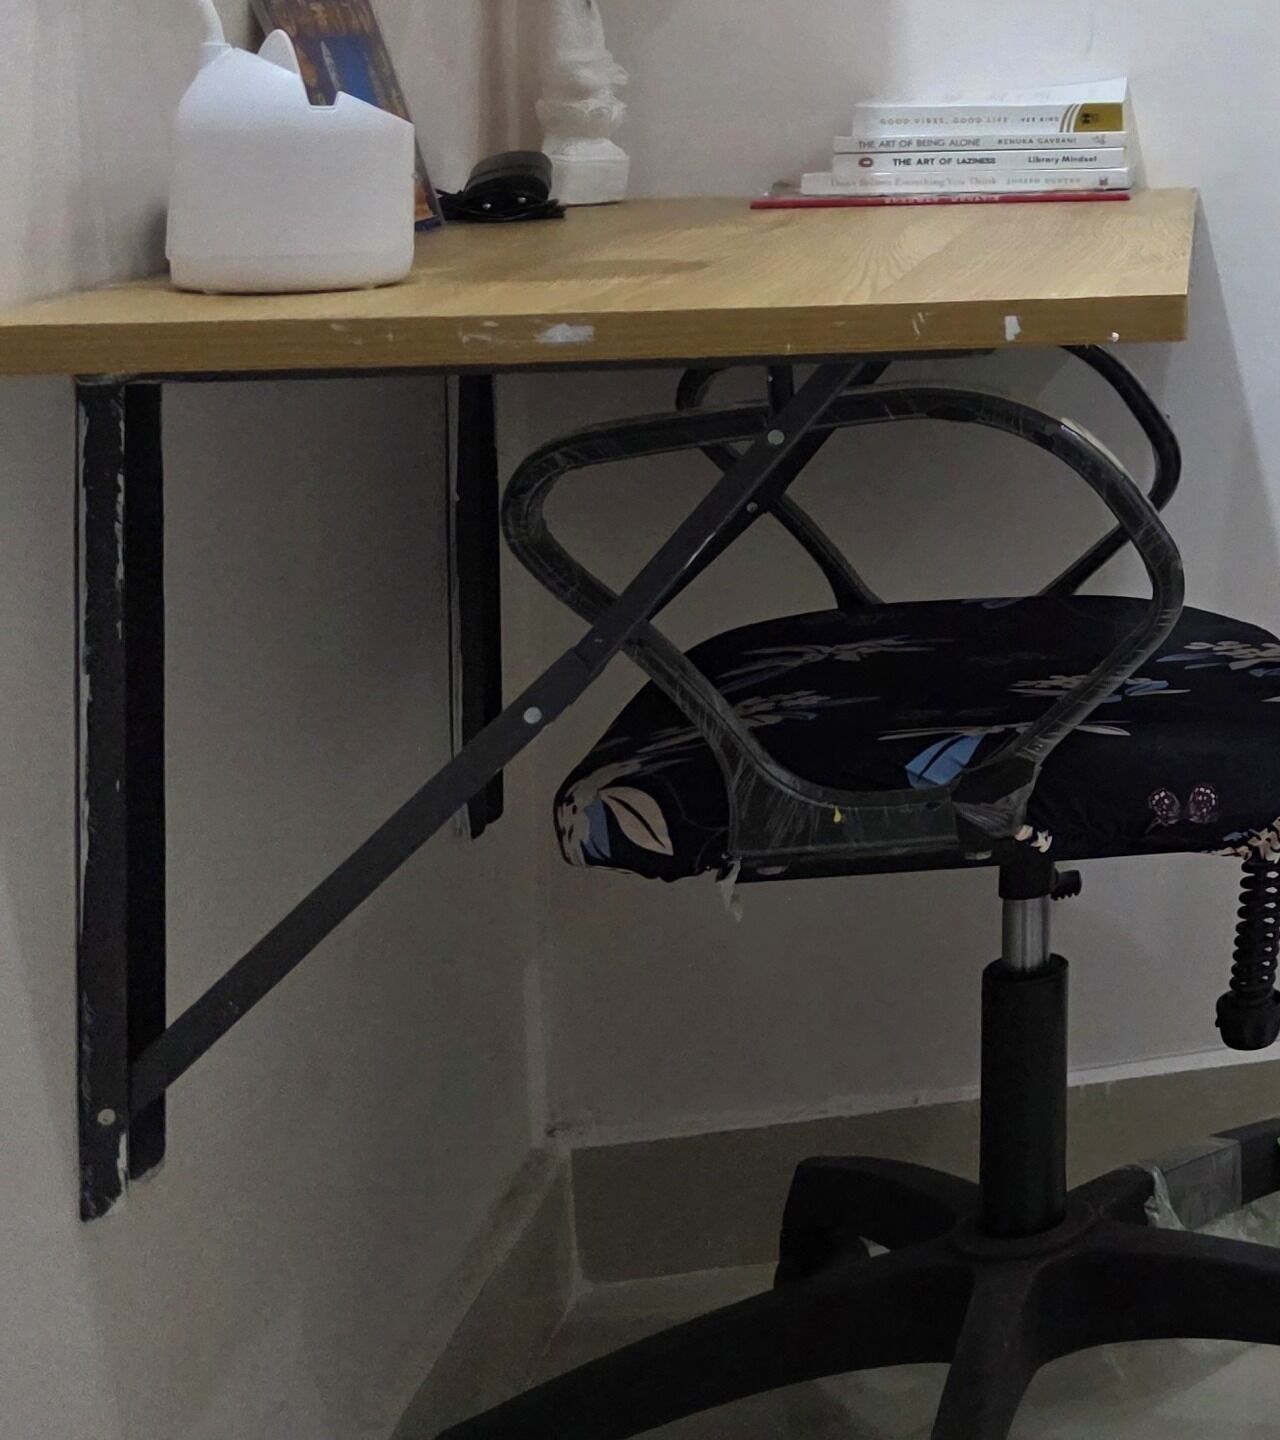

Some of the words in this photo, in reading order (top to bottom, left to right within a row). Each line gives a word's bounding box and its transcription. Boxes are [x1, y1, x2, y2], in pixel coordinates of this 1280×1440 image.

[879, 117, 910, 126] GOOD
[952, 116, 983, 125] GOOD
[858, 140, 875, 150] THE
[878, 139, 897, 149] ART
[899, 139, 913, 148] OF
[916, 138, 946, 148] BEING
[949, 138, 981, 147] ALONE
[997, 138, 1034, 146] RENUKA
[893, 158, 912, 167] THE
[916, 157, 935, 166] ART
[938, 157, 953, 166] OF
[956, 157, 996, 166] LAZINESS
[1027, 155, 1060, 165] Library
[1061, 154, 1098, 163] Mindset
